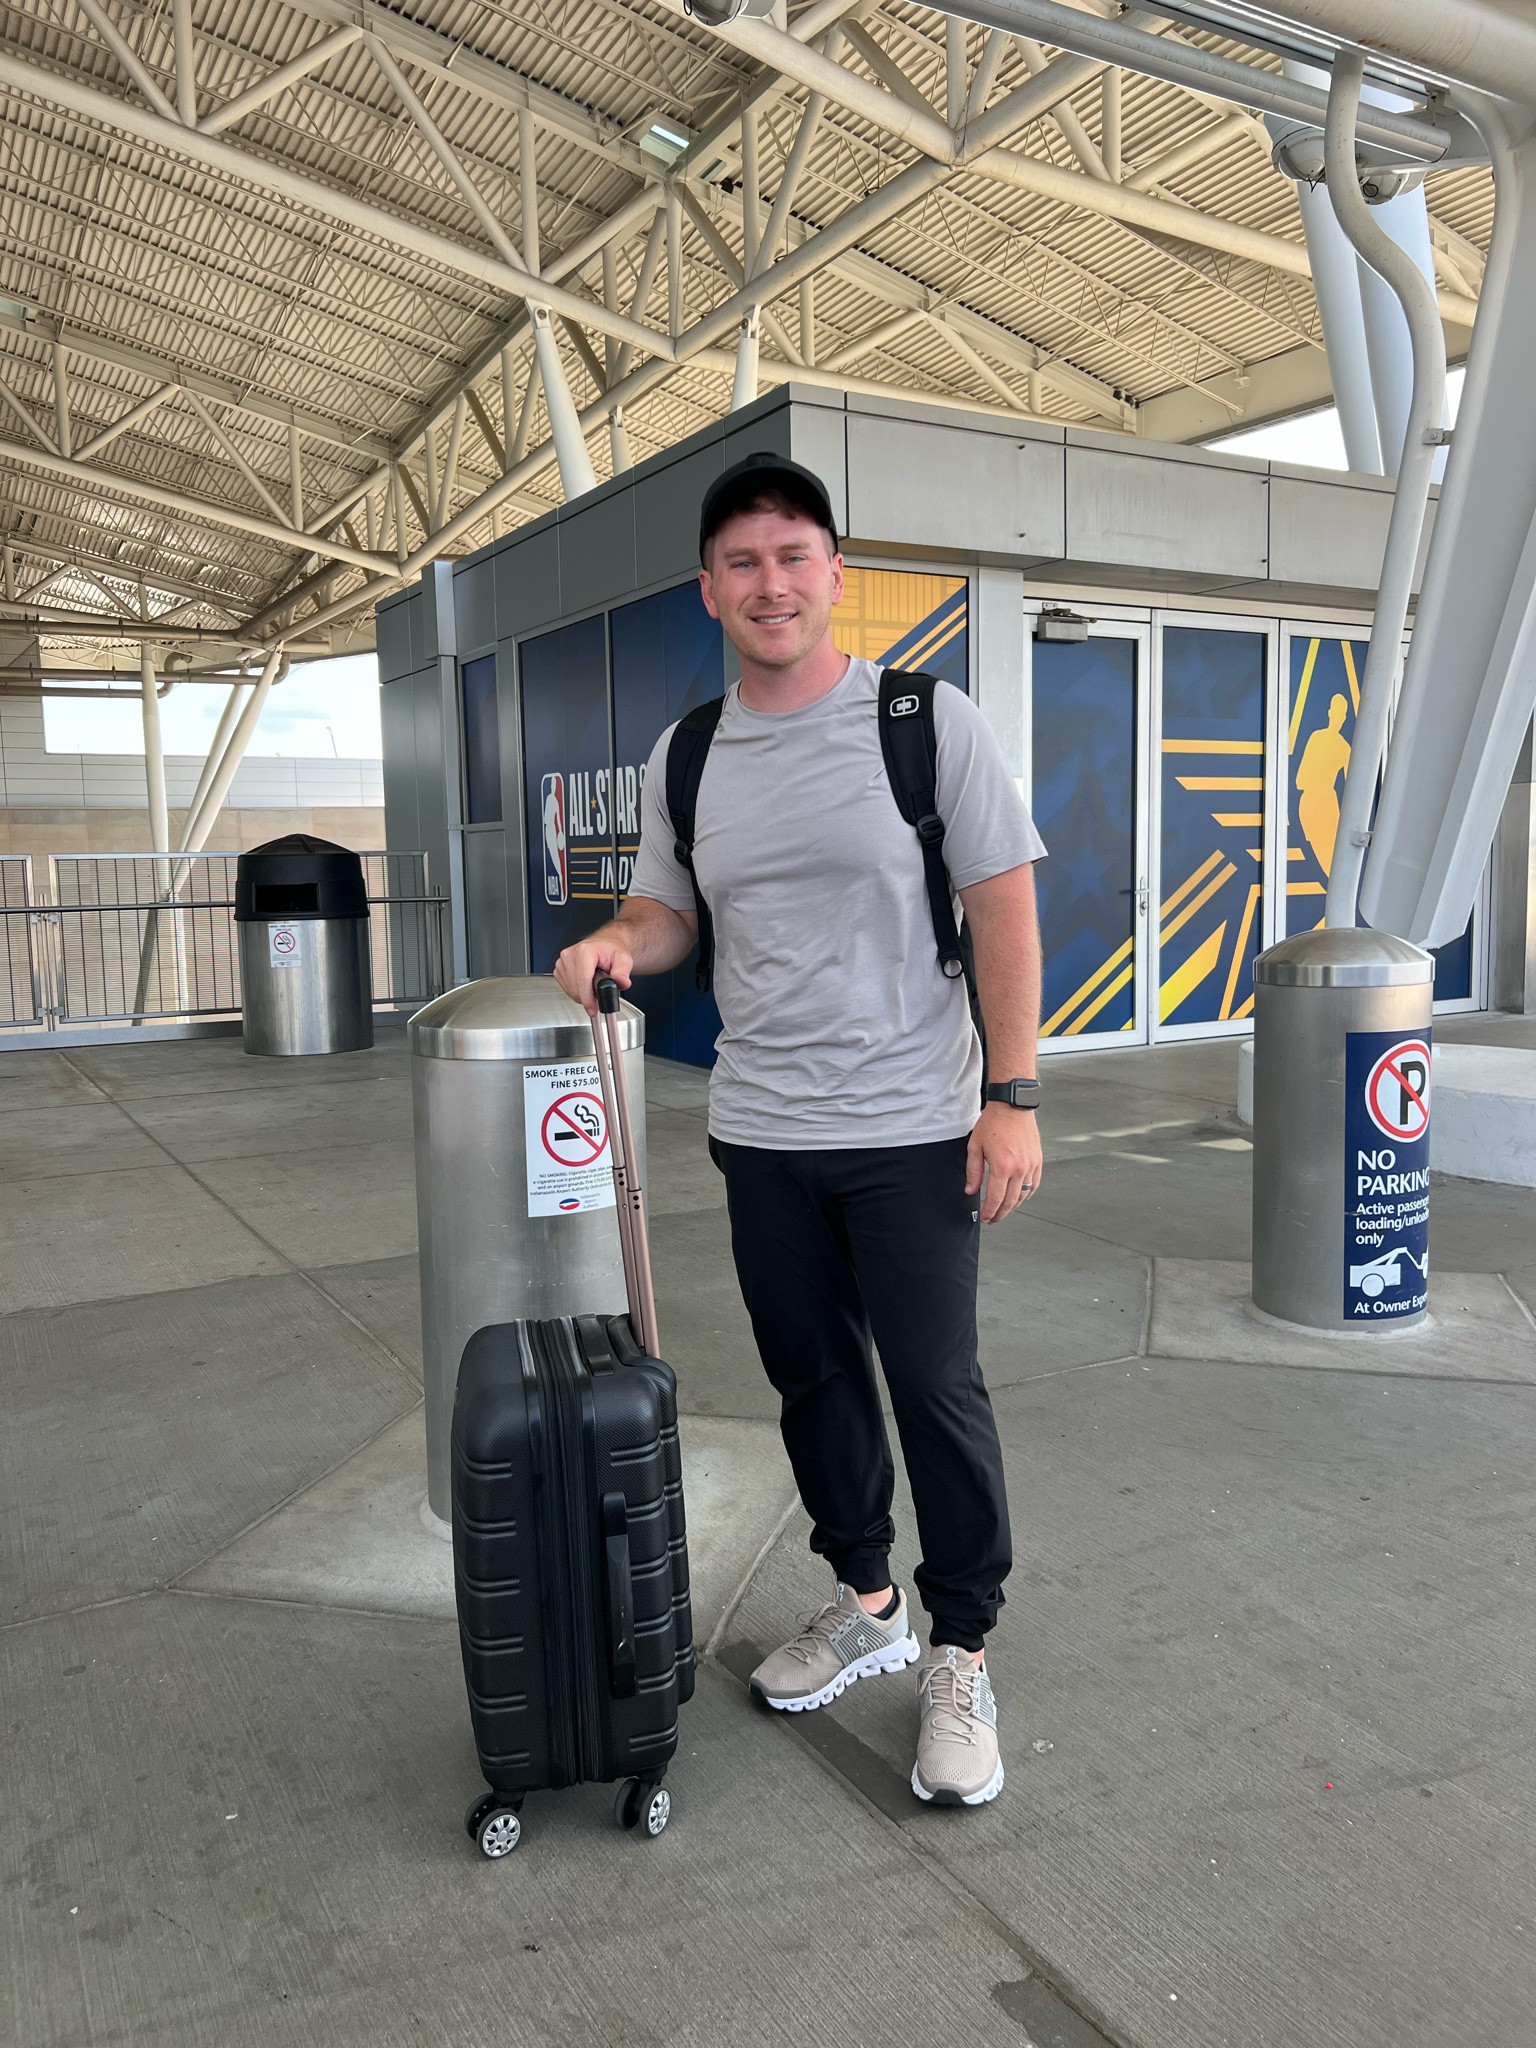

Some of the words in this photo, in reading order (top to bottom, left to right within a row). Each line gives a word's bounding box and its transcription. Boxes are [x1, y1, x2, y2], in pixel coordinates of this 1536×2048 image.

[569, 771, 594, 837] ALL
[595, 765, 638, 836] STAR
[525, 1069, 558, 1079] SMOKE
[565, 1066, 585, 1076] FREE
[551, 1081, 571, 1089] FINE
[573, 1077, 599, 1087] $75.00
[1358, 1149, 1396, 1170] NO
[1357, 1166, 1430, 1196] PARKING
[1356, 1202, 1394, 1215] Active
[1355, 1232, 1384, 1248] only
[1354, 1301, 1370, 1314] At
[1373, 1300, 1412, 1314] Owner
